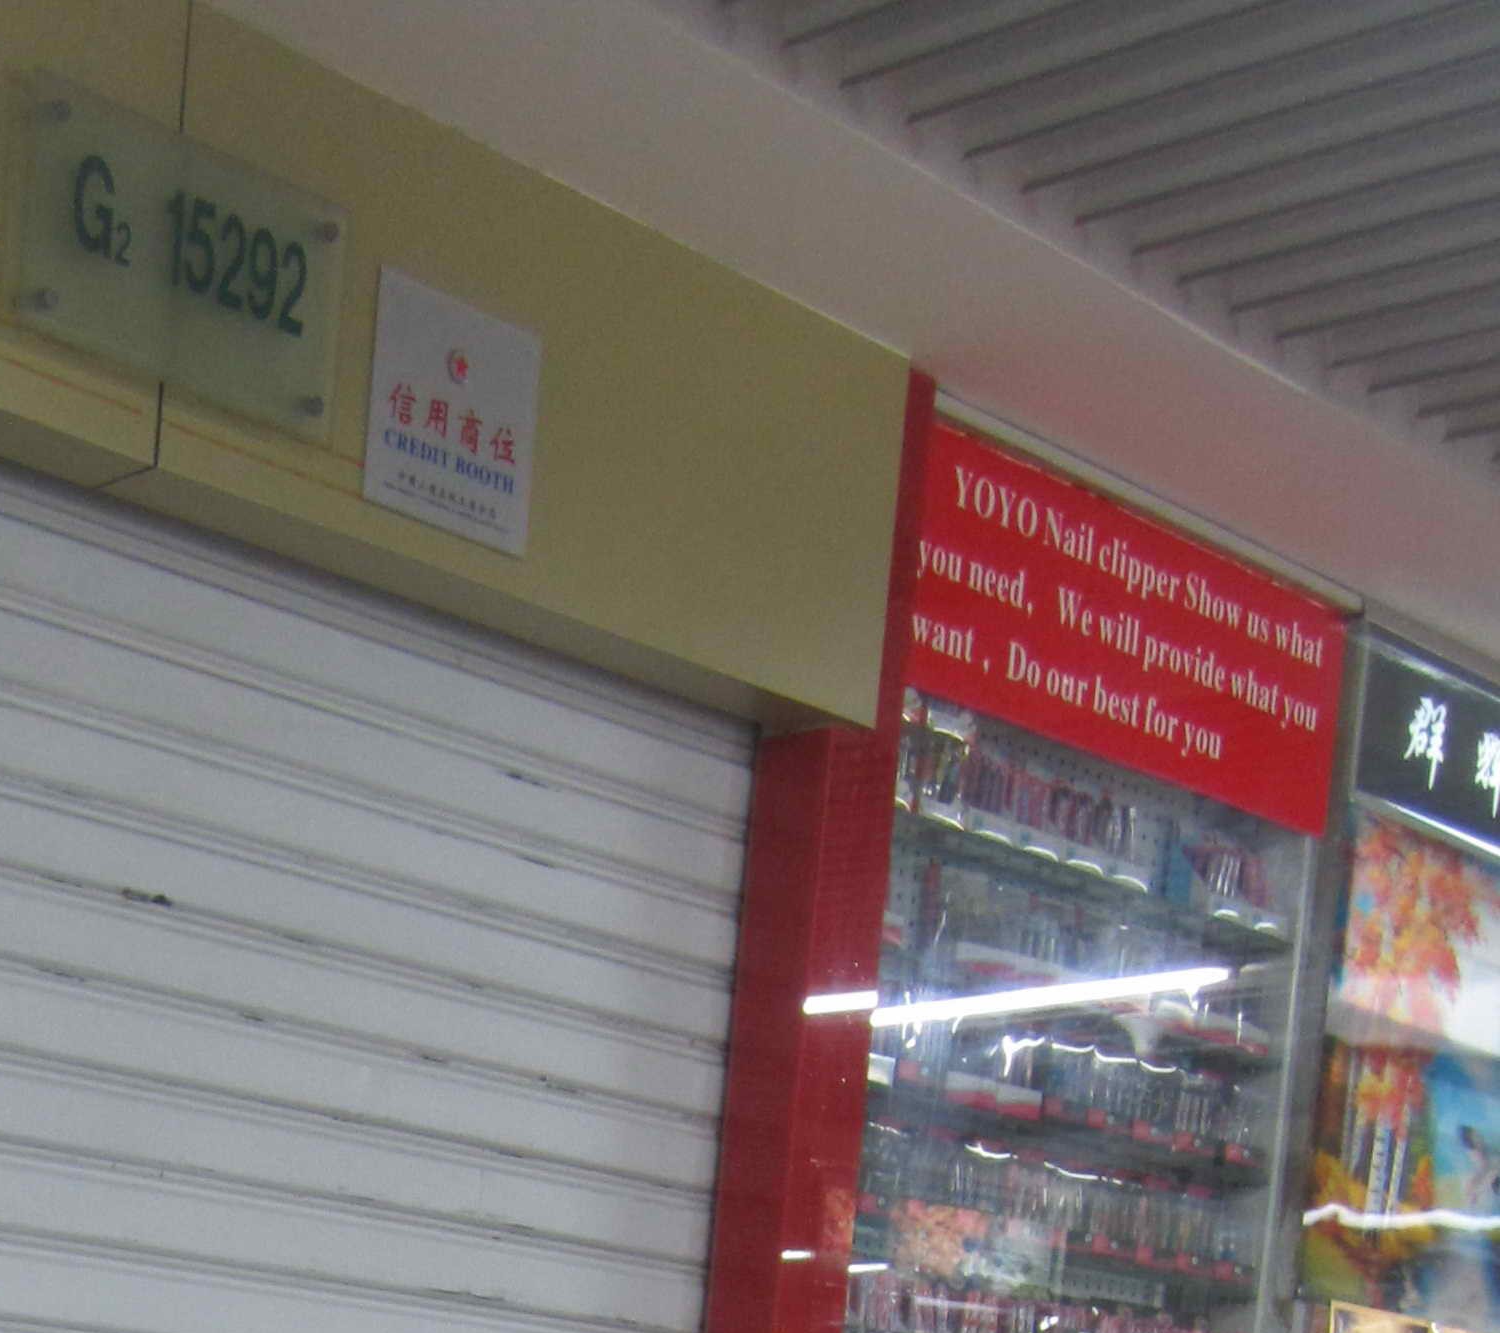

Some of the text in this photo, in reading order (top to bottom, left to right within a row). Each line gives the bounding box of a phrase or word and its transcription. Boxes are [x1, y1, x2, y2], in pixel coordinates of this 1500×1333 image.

[167, 189, 308, 338] 15292
[384, 428, 516, 495] CREDIT BOOTH
[389, 383, 516, 464] 信用商位
[955, 464, 1324, 668] YOYO Nail clipper Show us what
[916, 539, 962, 580] you
[1058, 586, 1093, 637] We
[1099, 612, 1140, 657] will
[1143, 634, 1226, 693] provide
[1231, 668, 1279, 716] what
[1280, 695, 1318, 732] you
[1007, 640, 1041, 688] Do
[1047, 668, 1088, 710] our
[1093, 675, 1140, 727] best
[1144, 696, 1179, 742] for
[1181, 721, 1222, 760] you
